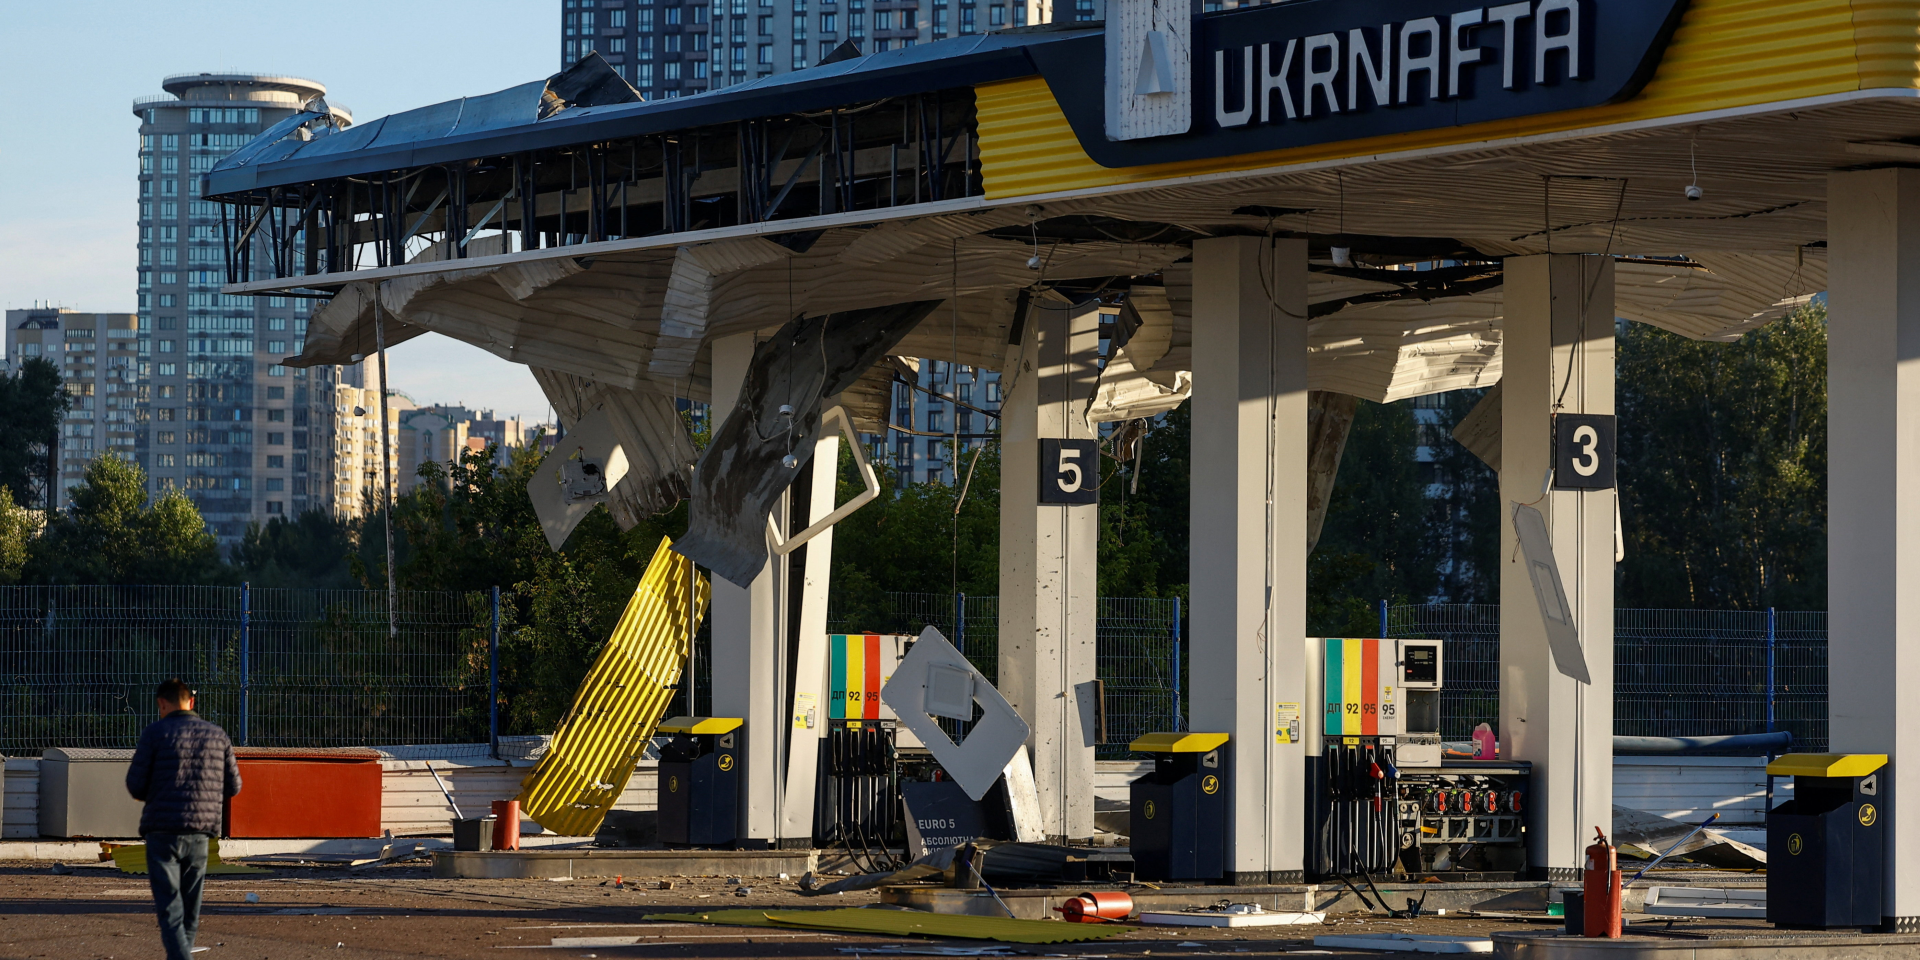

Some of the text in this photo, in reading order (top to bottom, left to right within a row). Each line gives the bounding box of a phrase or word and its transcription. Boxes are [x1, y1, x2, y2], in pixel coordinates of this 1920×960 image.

[1214, 0, 1580, 128] UKRNAFTA
[1570, 425, 1599, 478] 3
[1057, 448, 1082, 494] 5
[831, 691, 879, 702] ДП 92 95
[1326, 702, 1395, 715] ДП 92 95 95
[918, 818, 956, 830] EURO 5
